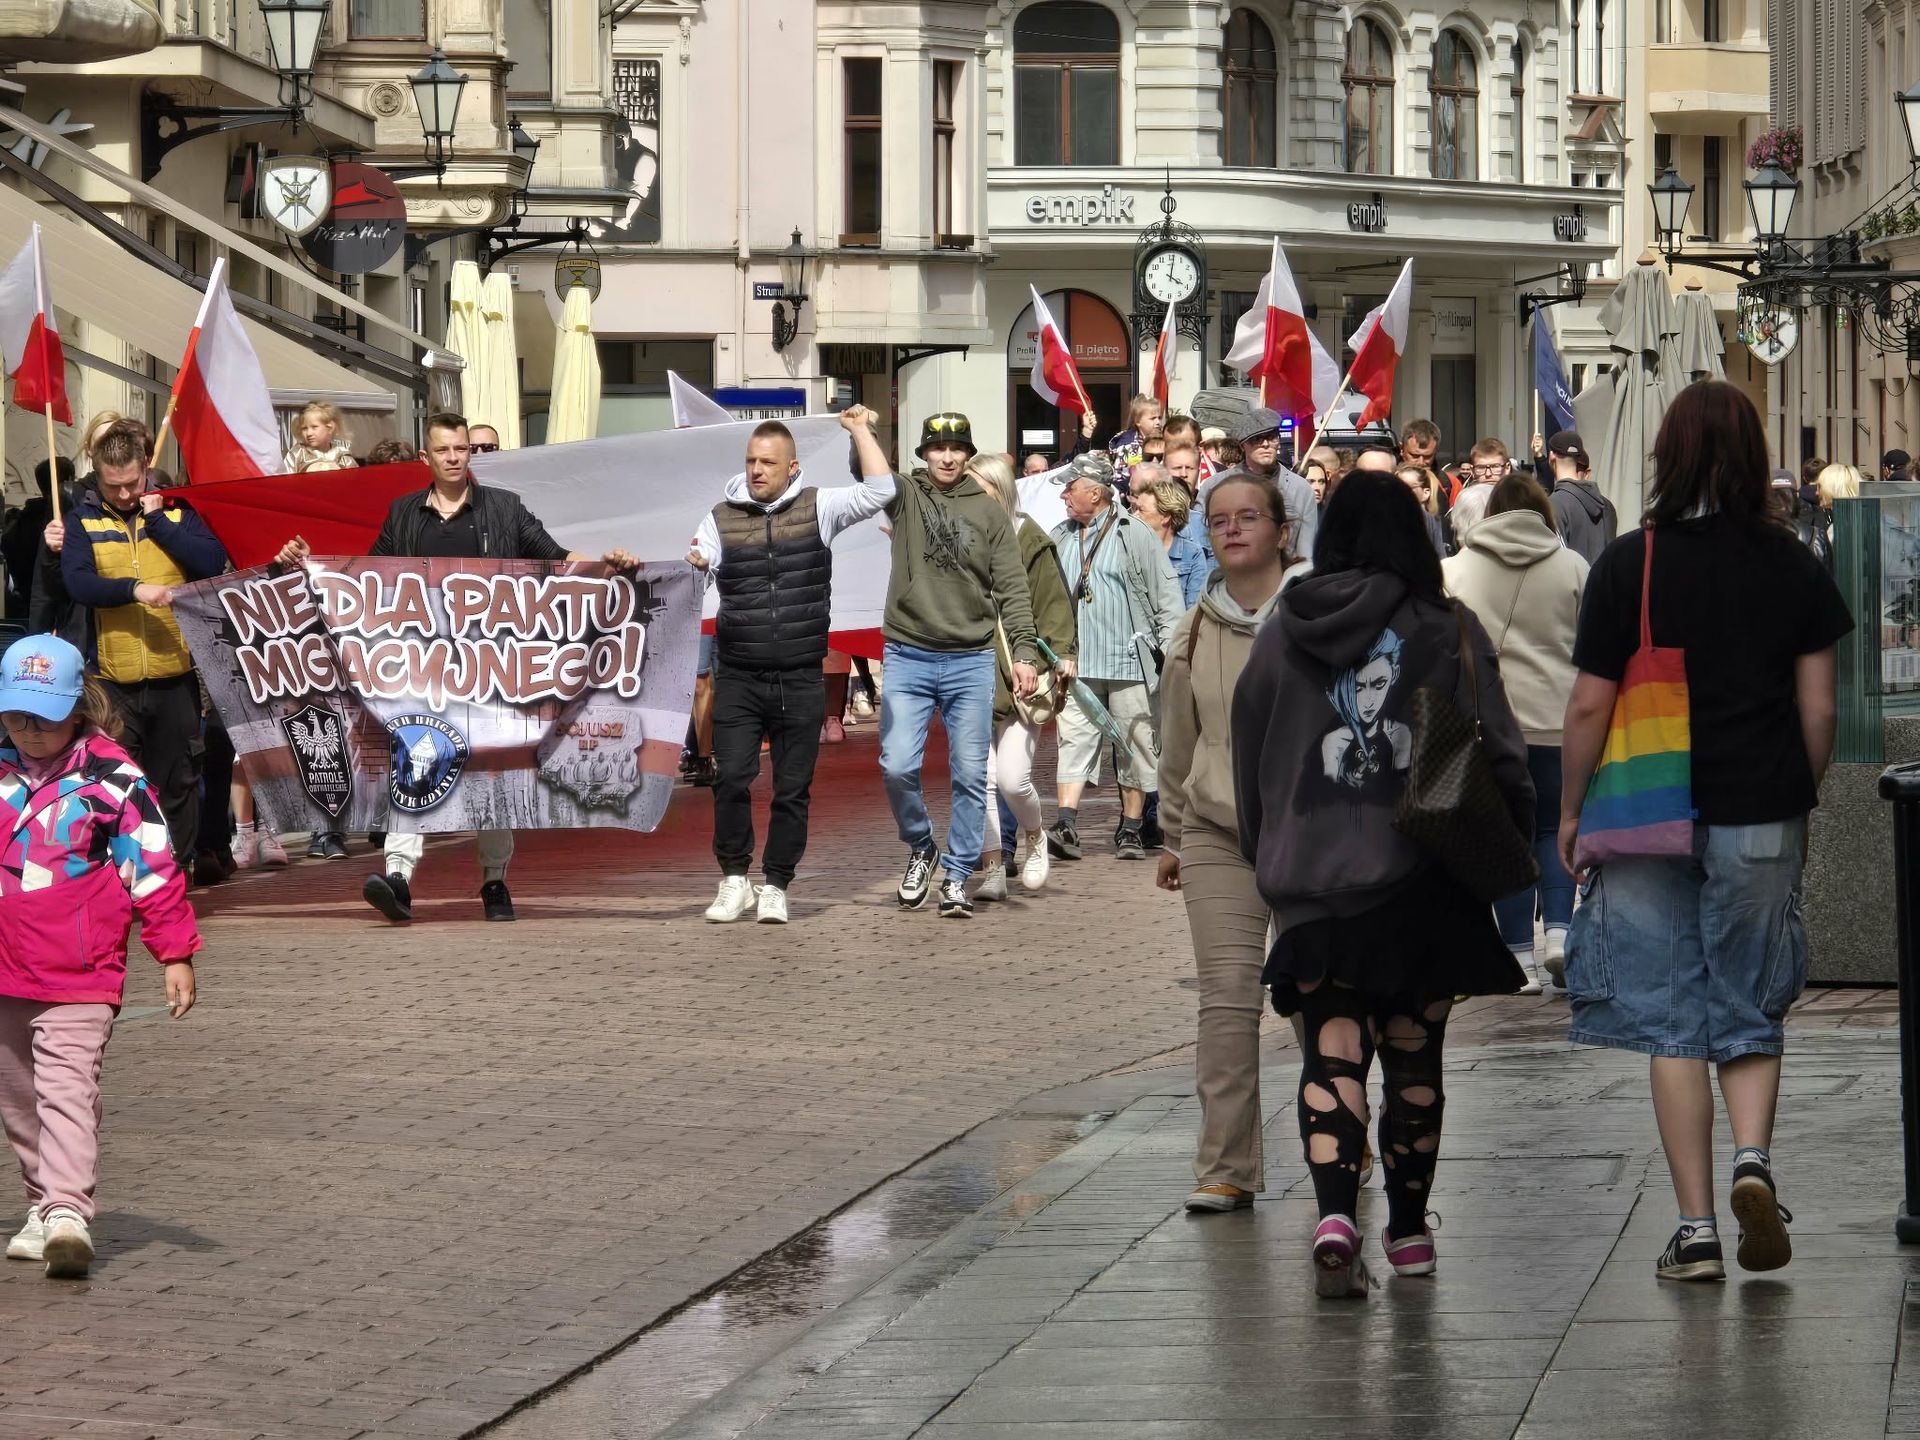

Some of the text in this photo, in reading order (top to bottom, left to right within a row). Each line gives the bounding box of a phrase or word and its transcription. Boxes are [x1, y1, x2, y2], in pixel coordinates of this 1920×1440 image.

[615, 91, 655, 106] EGO
[1026, 184, 1135, 226] empik
[1351, 197, 1388, 233] empik
[1087, 344, 1120, 356] piętro
[218, 571, 635, 645] NIE DLA PAKTU
[415, 716, 466, 752] BRIGADE
[308, 771, 345, 784] PATROLE
[420, 768, 458, 806] GDYNIA
